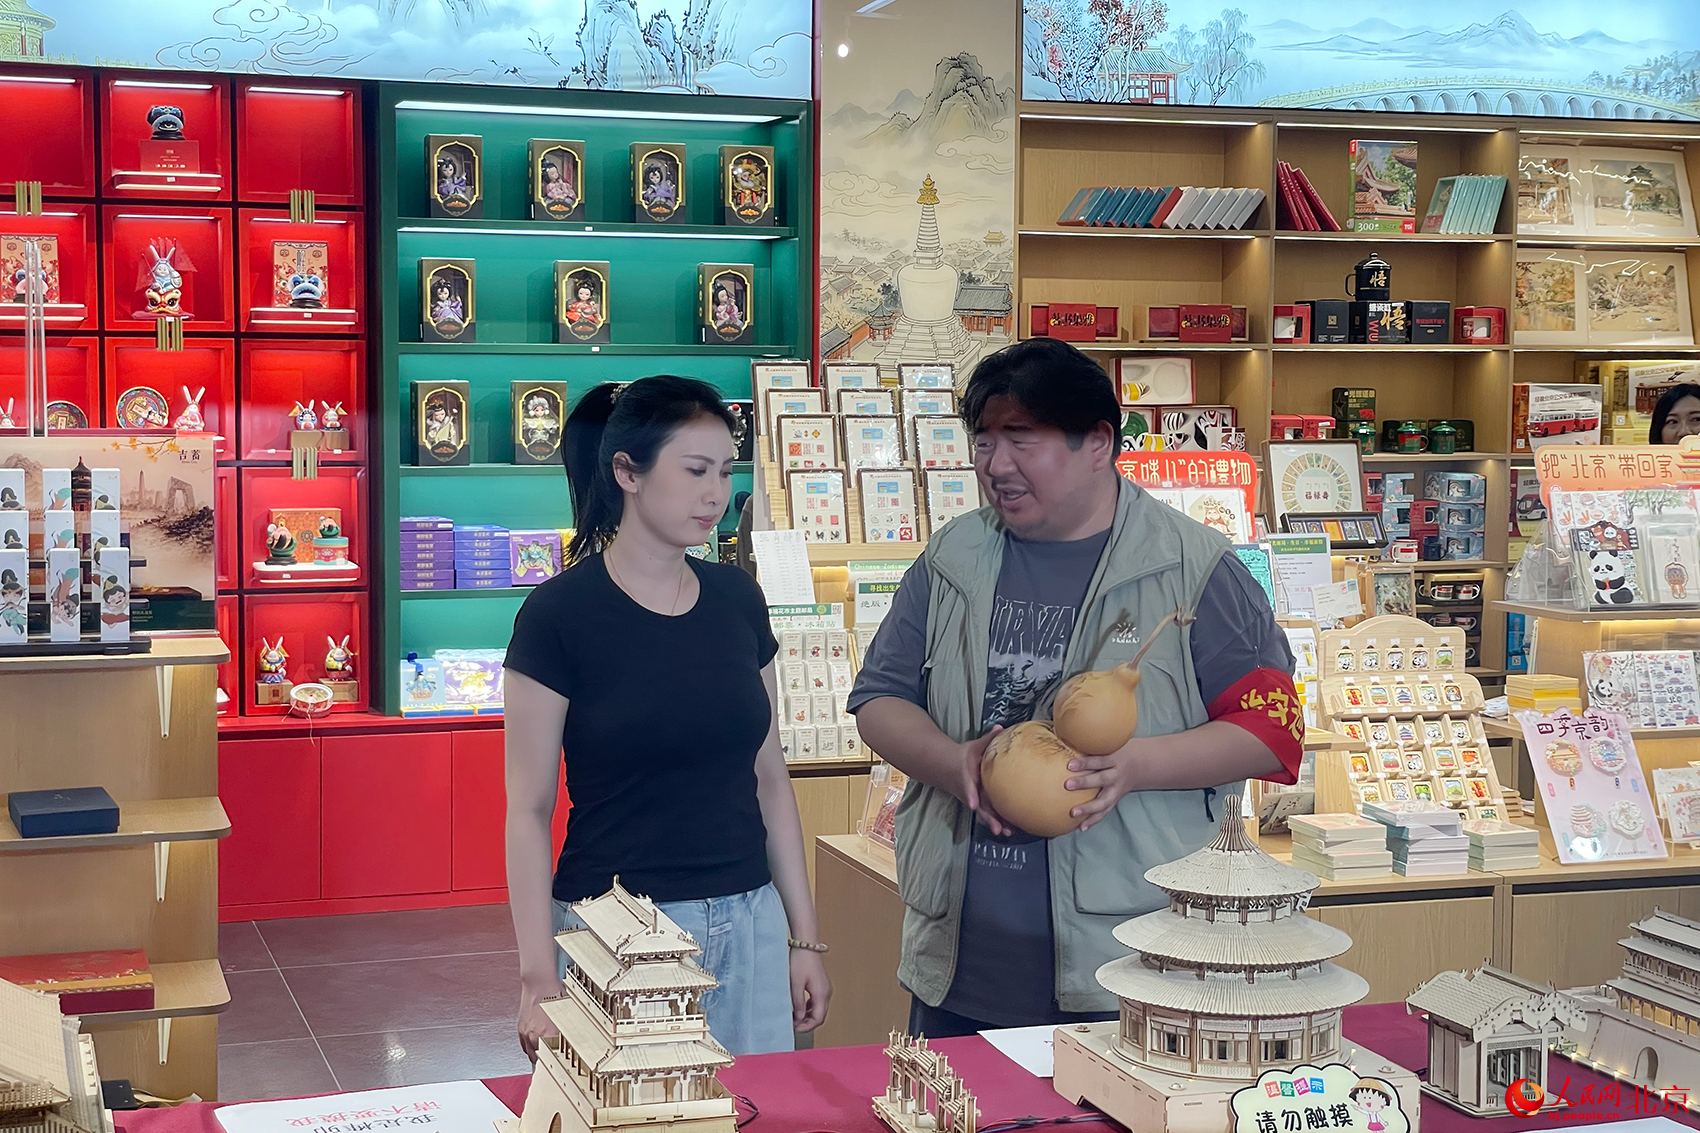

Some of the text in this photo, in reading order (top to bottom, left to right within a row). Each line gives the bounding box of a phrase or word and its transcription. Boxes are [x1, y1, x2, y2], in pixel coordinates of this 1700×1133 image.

[1357, 223, 1375, 232] 300
[1368, 319, 1379, 343] WU
[1379, 305, 1407, 331] 悟
[1536, 713, 1610, 741] 四季京韵
[1255, 1102, 1354, 1133] 请勿触摸
